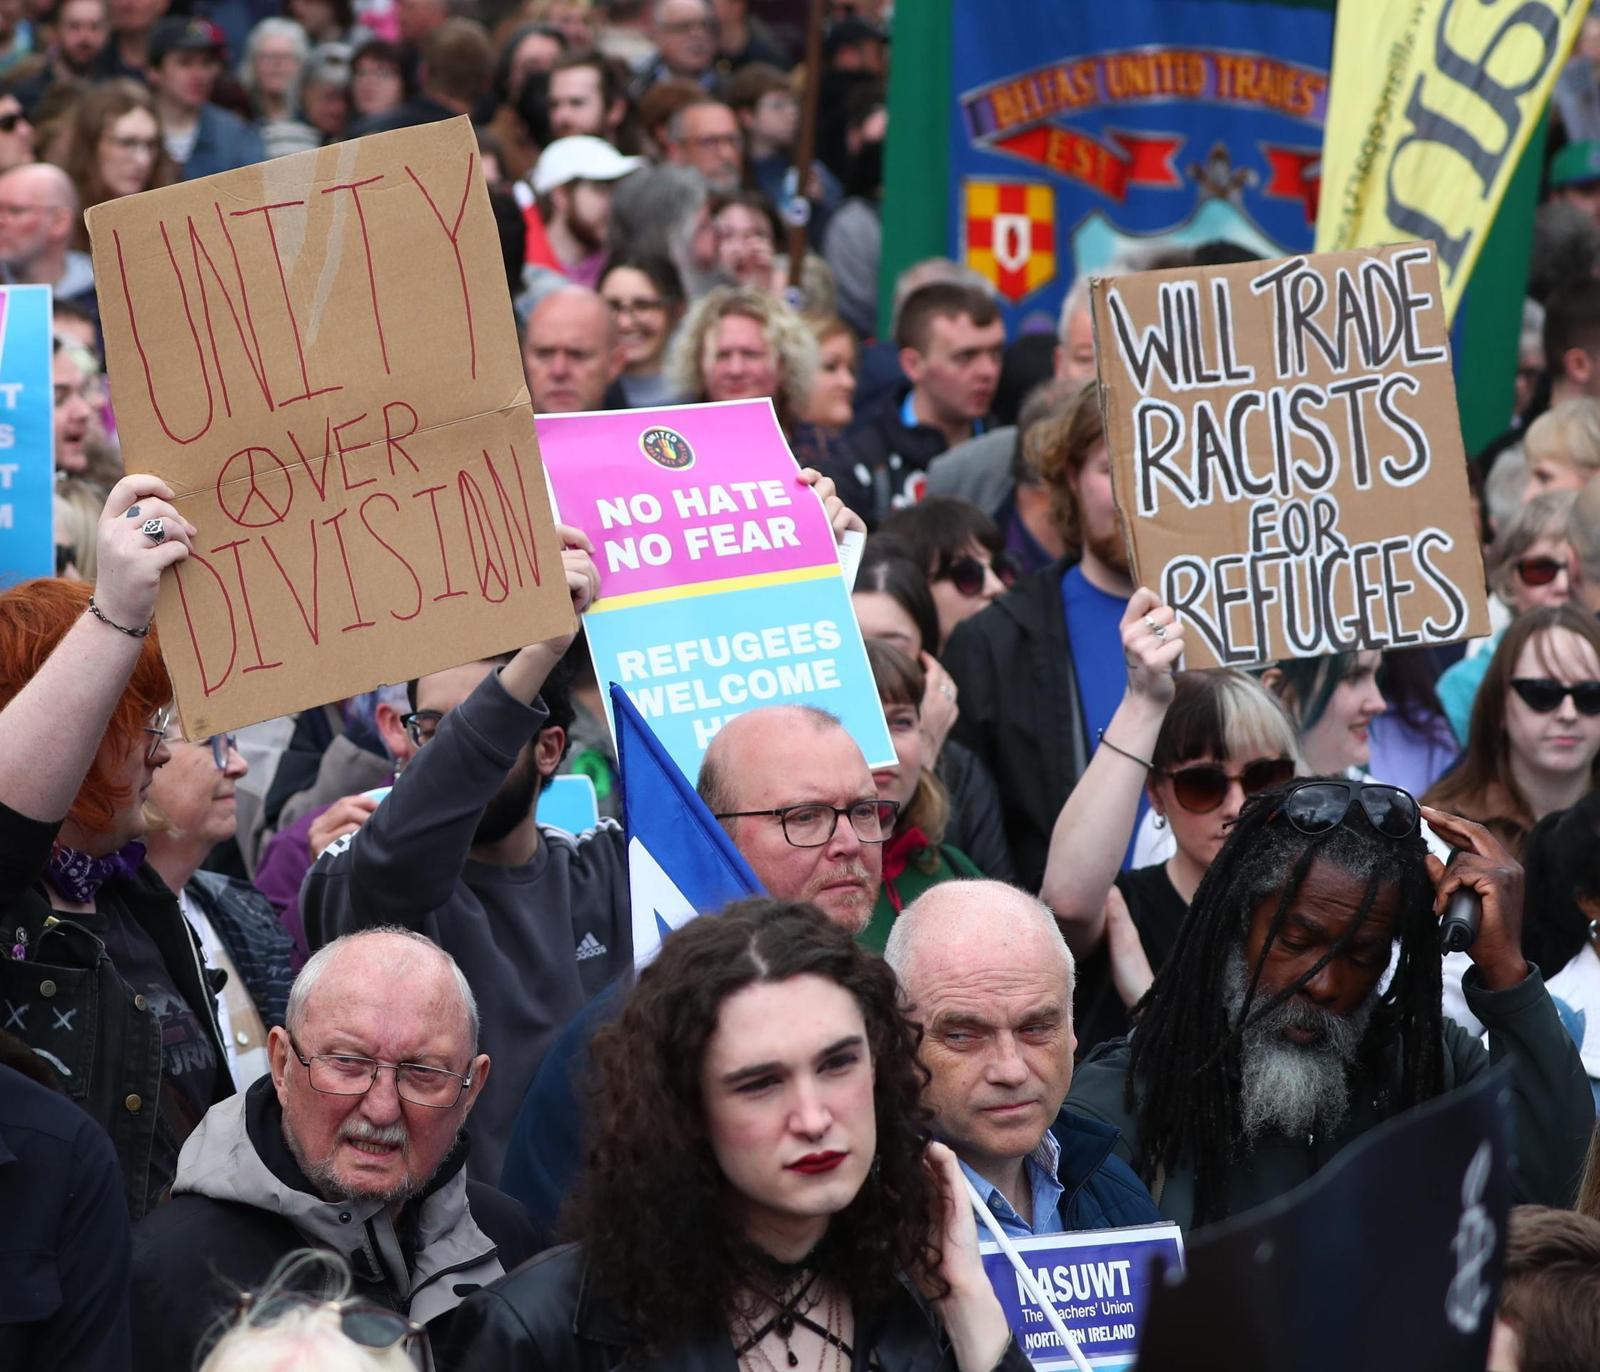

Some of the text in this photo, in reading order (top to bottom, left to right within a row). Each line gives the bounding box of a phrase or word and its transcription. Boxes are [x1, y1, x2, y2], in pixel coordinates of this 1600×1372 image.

[1105, 51, 1206, 98] UNITED
[112, 152, 477, 445] UNITY
[1104, 247, 1447, 394] WILL TRADE
[1133, 371, 1431, 517] RACISTS
[596, 480, 792, 529] NO HATE
[1249, 493, 1348, 559] FOR
[170, 444, 542, 697] DIVISION
[602, 534, 673, 574] NO
[683, 516, 801, 560] FEAR
[1159, 528, 1469, 671] REFUGEES
[615, 619, 843, 683] REFUGEES
[625, 658, 842, 718] WELCOME
[1022, 1301, 1134, 1323] The achers' Union
[1025, 1323, 1136, 1349] NORTHRN IRELAND
